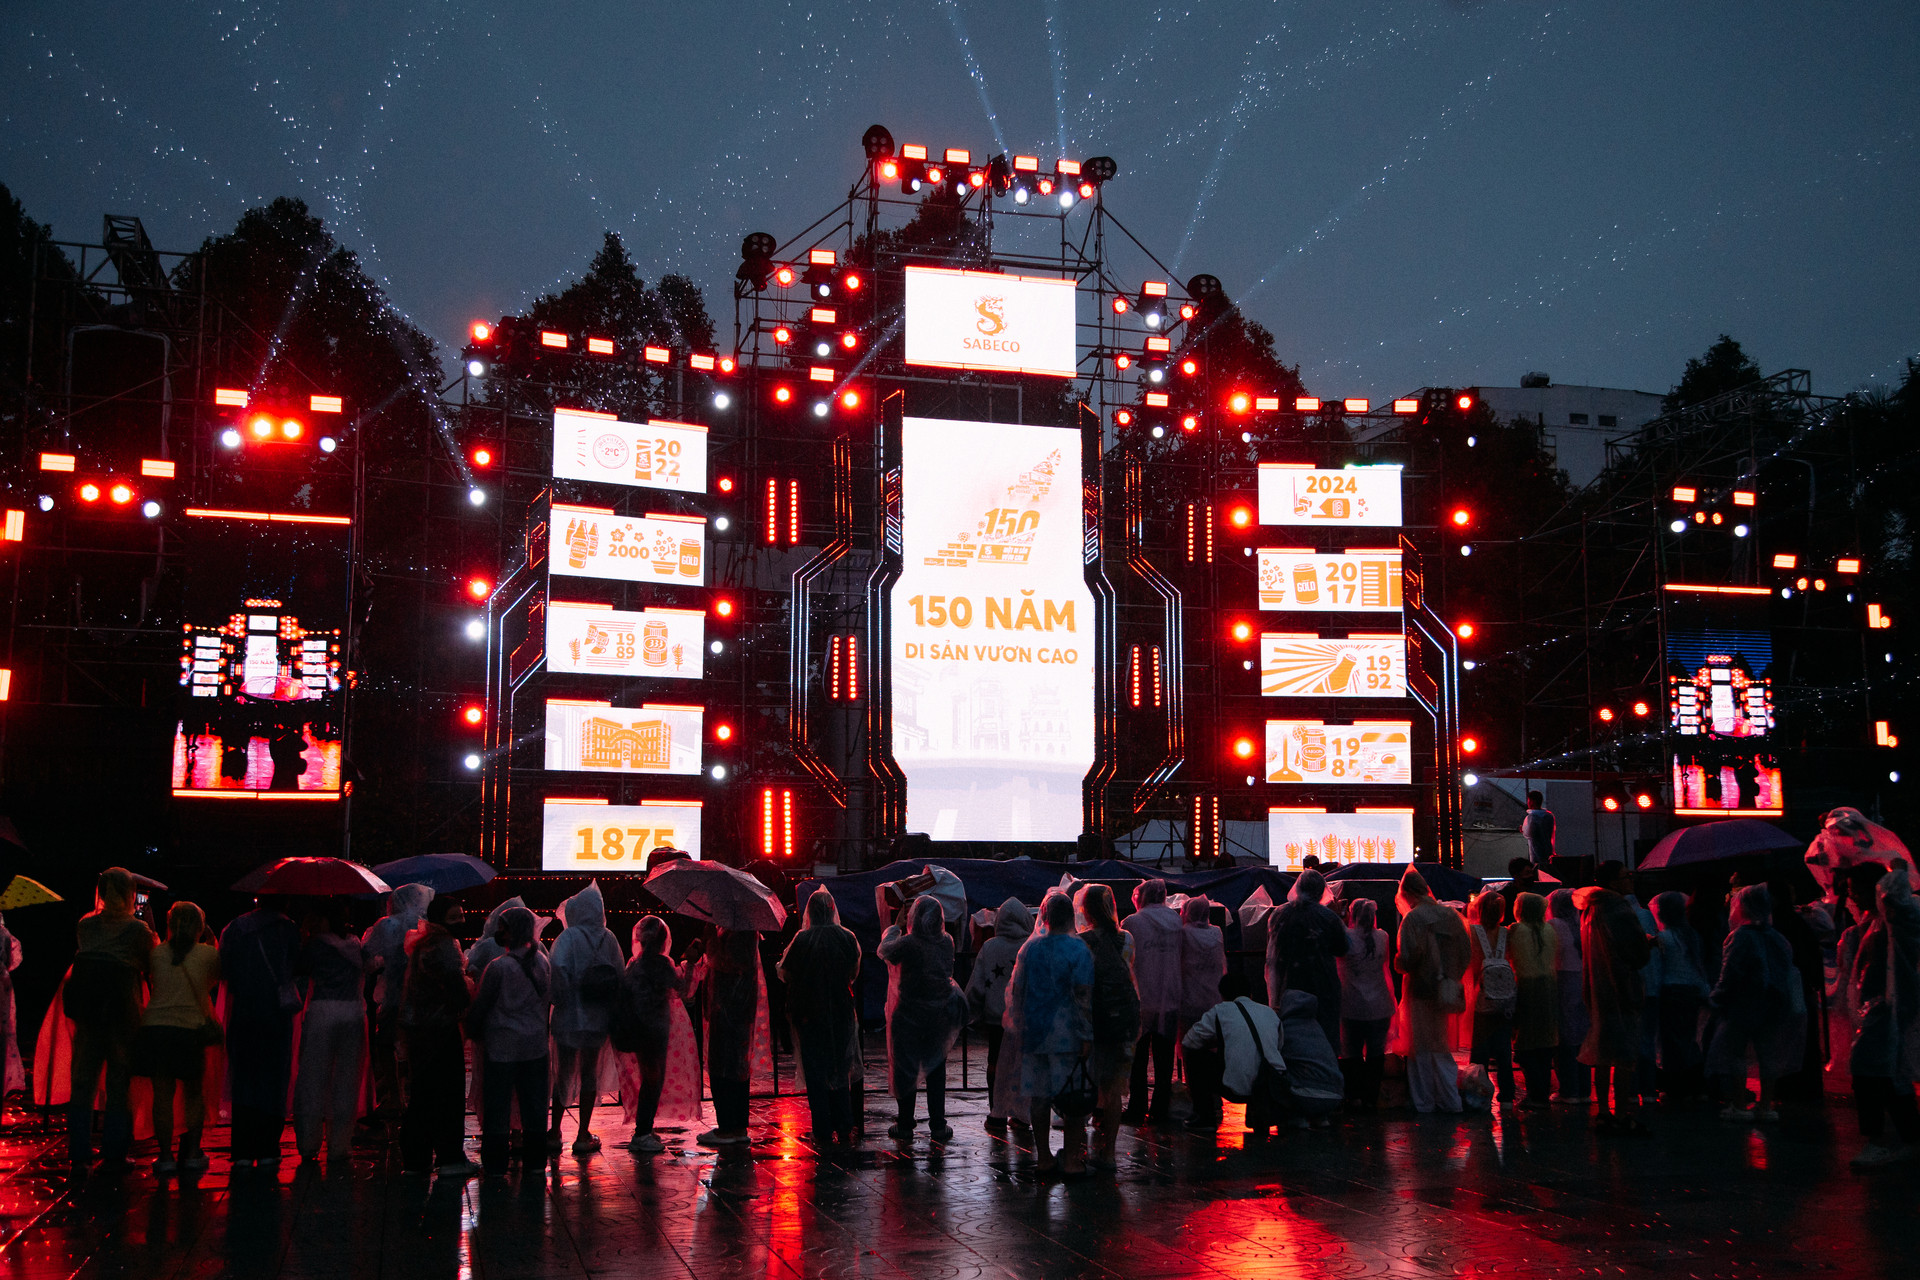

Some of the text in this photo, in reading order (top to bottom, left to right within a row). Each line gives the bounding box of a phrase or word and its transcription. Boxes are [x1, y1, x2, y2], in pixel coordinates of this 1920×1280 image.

[963, 337, 1020, 353] SABECO
[654, 438, 681, 458] 20
[655, 457, 681, 477] 22
[1306, 475, 1358, 494] 2024
[985, 508, 1040, 537] 150
[608, 543, 650, 560] 2000
[681, 555, 699, 567] GOLD
[1325, 562, 1358, 582] 20
[1296, 580, 1316, 593] GOLD
[1326, 583, 1357, 604] 17
[908, 588, 1077, 633] 150 NĂM
[616, 632, 636, 646] 19
[649, 639, 664, 648] 333
[616, 646, 636, 660] 89
[905, 639, 1079, 664] DI SẢN VƯƠN CAO
[1366, 655, 1391, 671] 19
[1366, 673, 1392, 689] 92
[1331, 737, 1361, 757] 19
[576, 827, 675, 861] 1875
